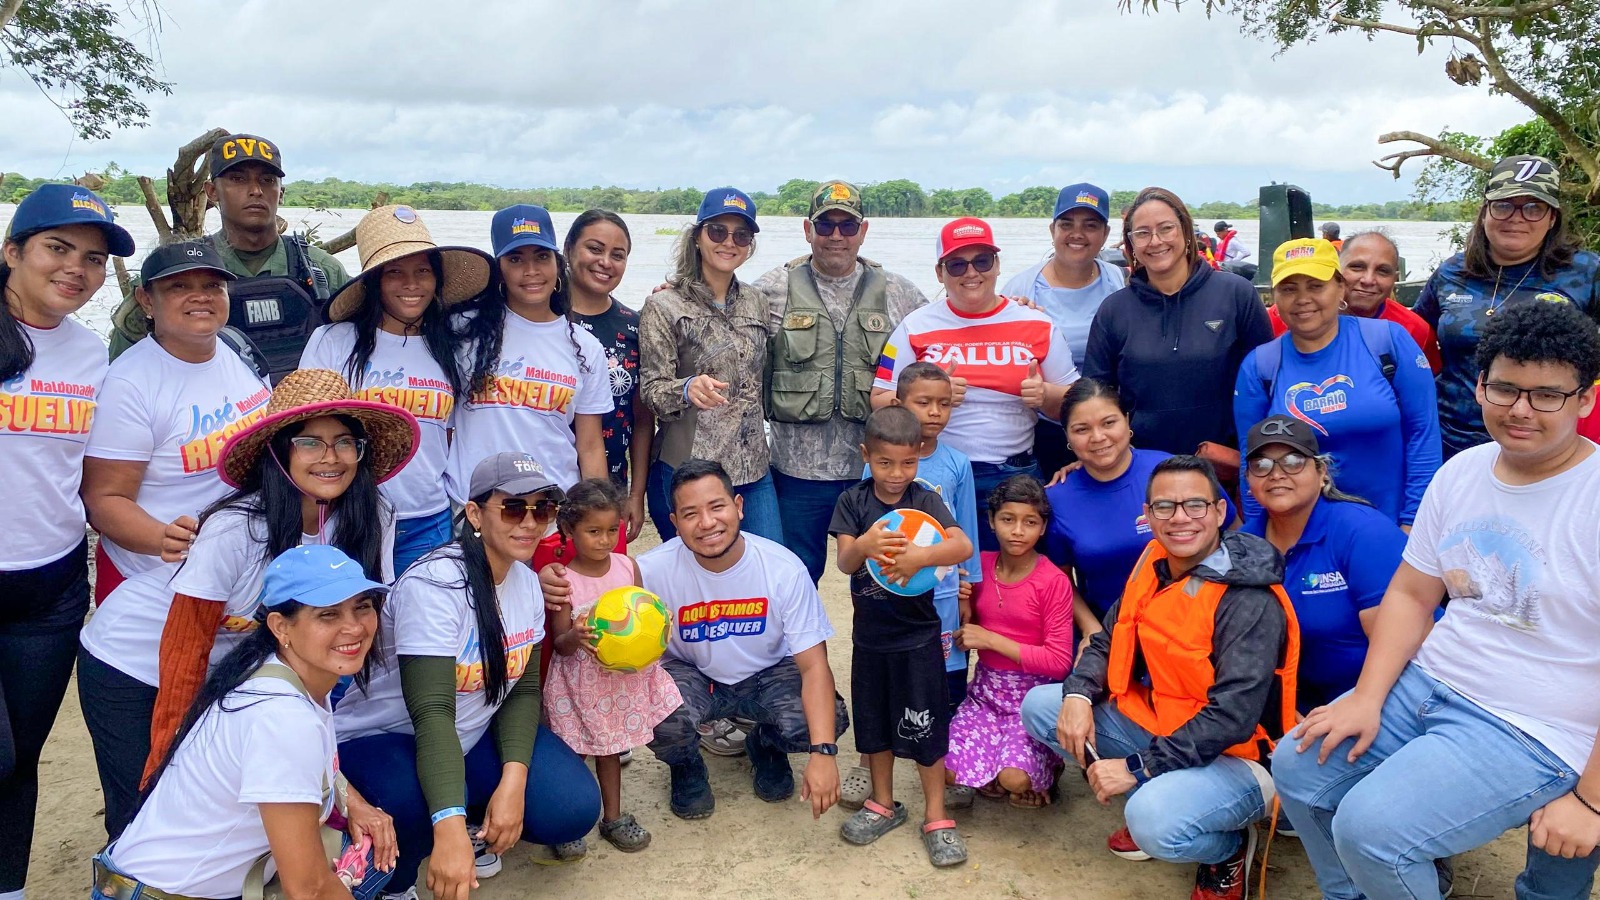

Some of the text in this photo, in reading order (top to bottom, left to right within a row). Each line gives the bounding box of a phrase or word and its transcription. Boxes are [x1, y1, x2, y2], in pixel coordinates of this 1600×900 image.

[223, 139, 273, 160] CVC
[187, 248, 203, 257] alo
[245, 300, 280, 322] FANB
[924, 345, 1035, 365] SALUD
[525, 367, 577, 387] Maldonado
[31, 379, 95, 398] Maldonado
[1304, 391, 1346, 411] BARRIO
[176, 395, 237, 446] José
[1260, 419, 1295, 436] CK
[1447, 521, 1545, 560] YELLOWSTONE
